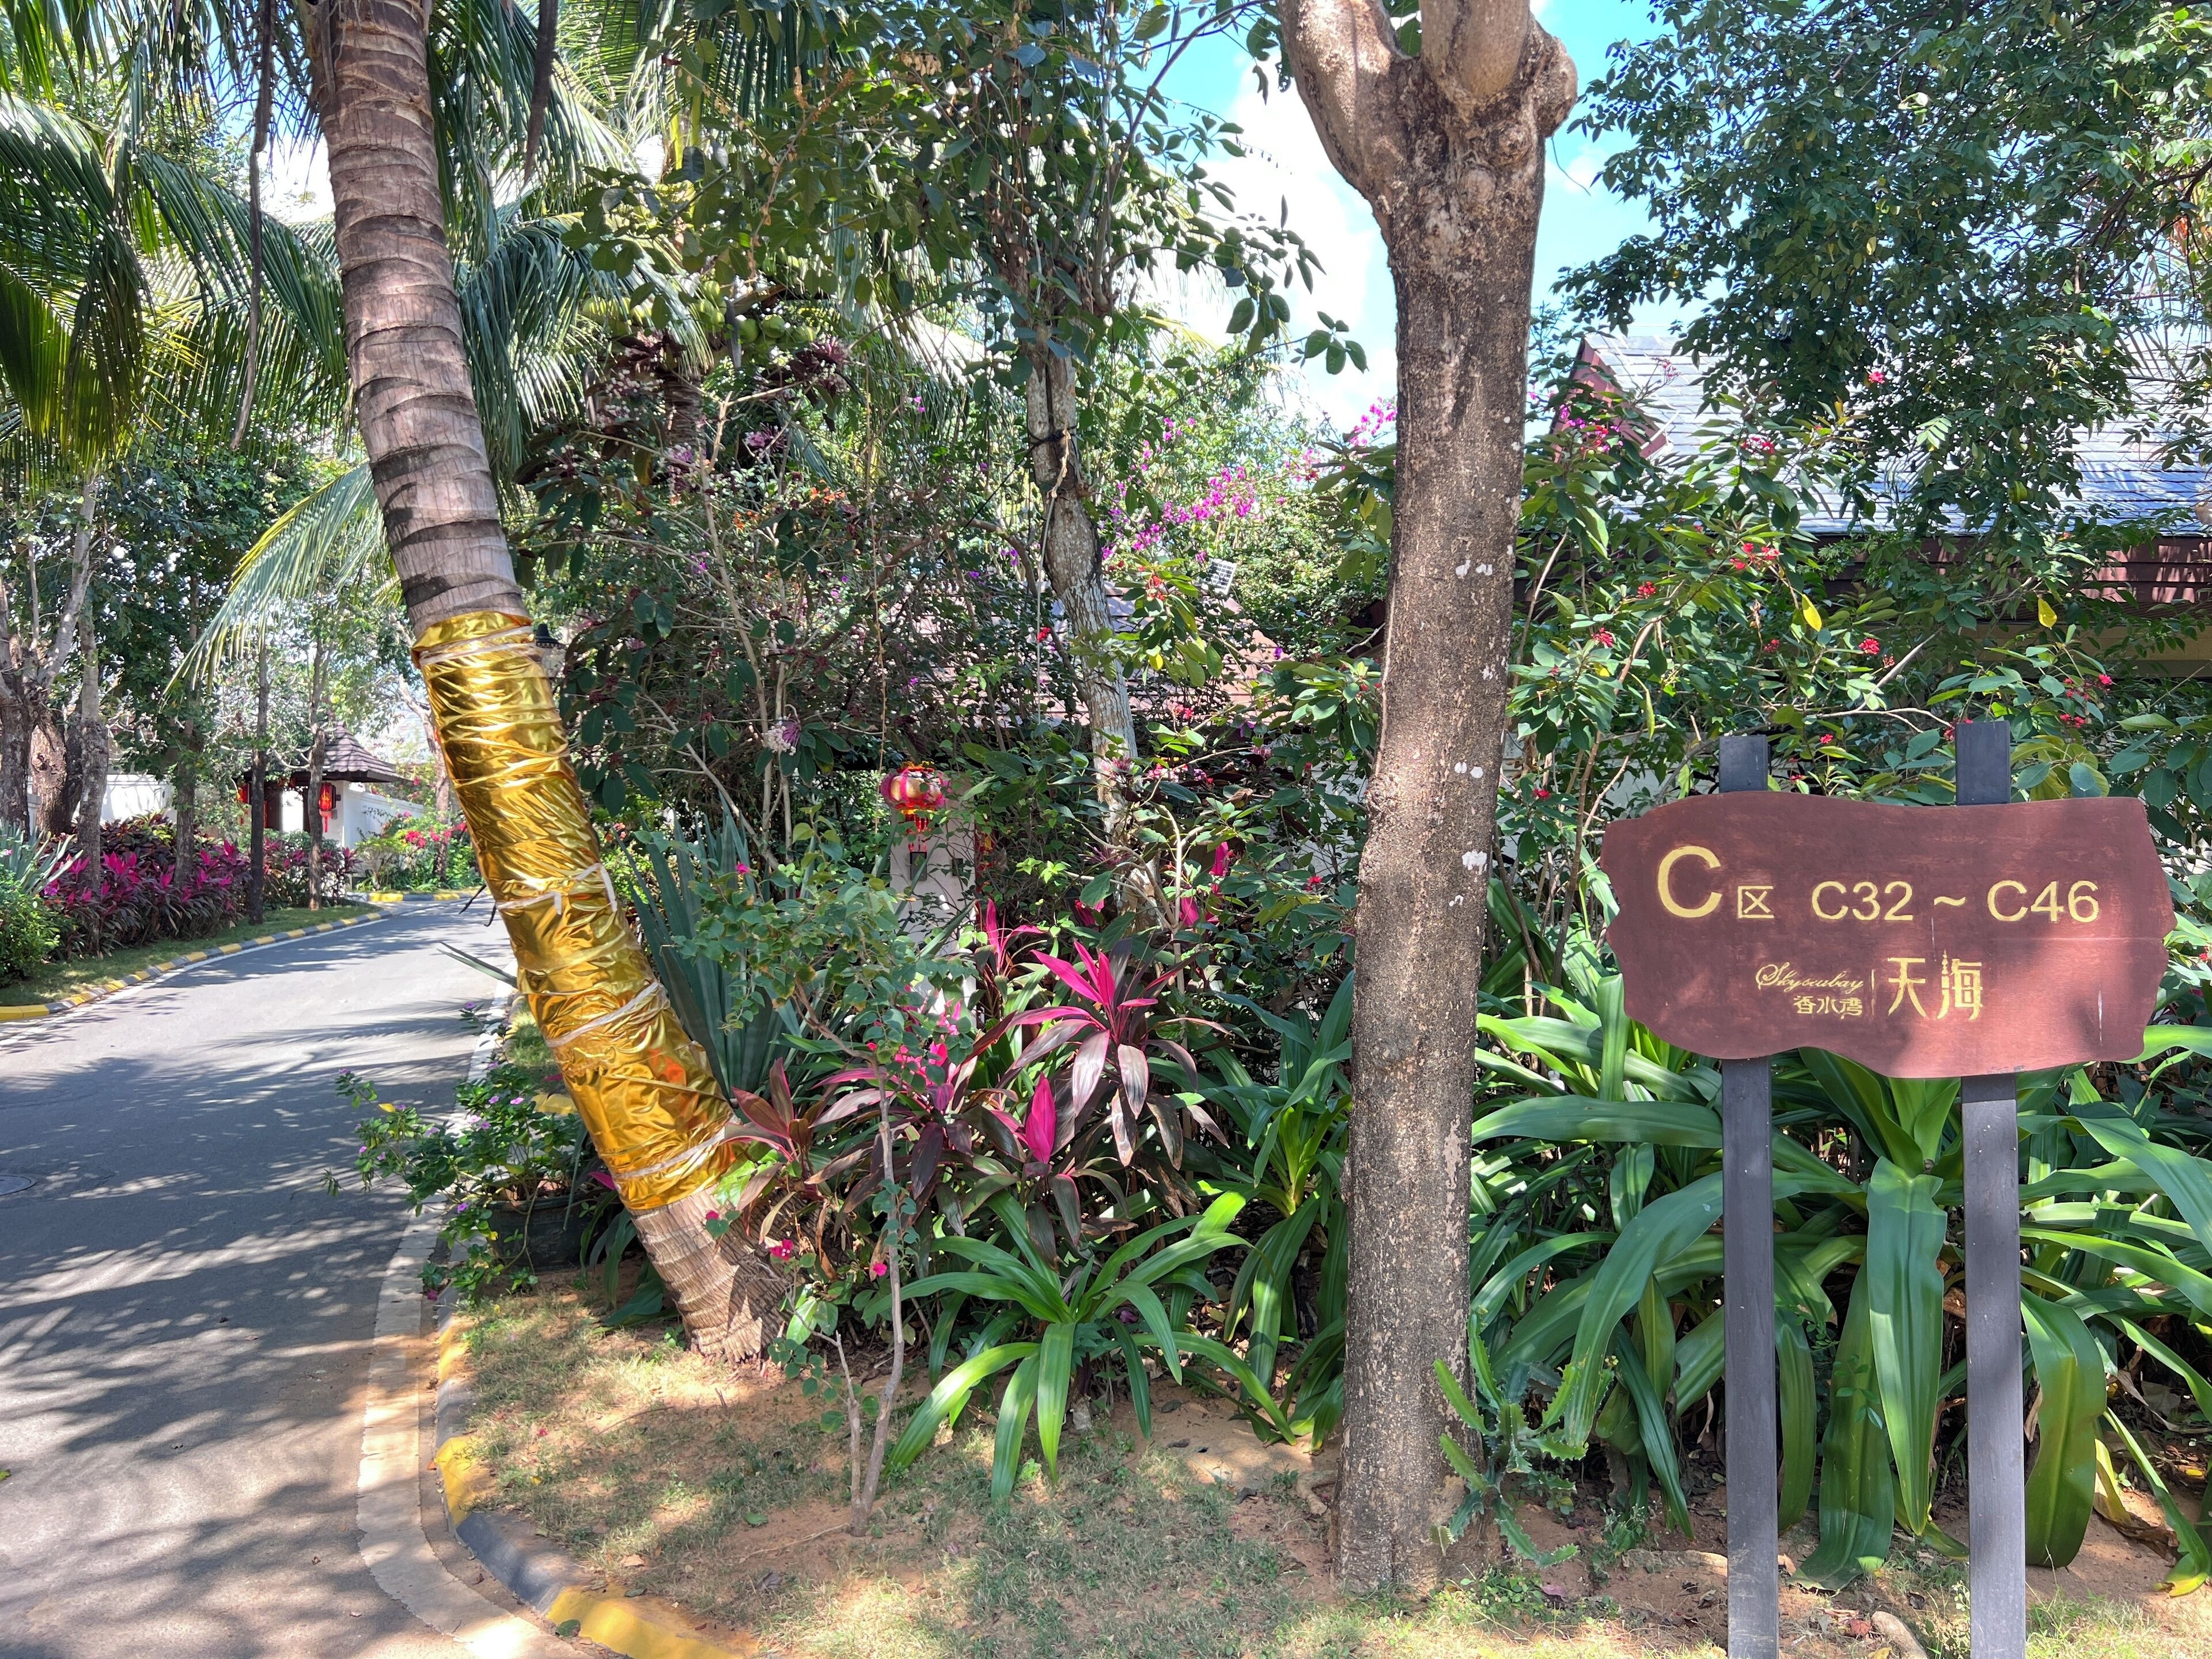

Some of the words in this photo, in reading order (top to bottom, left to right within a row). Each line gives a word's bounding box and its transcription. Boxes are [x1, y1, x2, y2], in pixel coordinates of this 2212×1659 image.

[1812, 881, 1914, 921] C32
[1987, 880, 2099, 922] C46
[1887, 949, 1983, 1020] 天海
[1793, 995, 1863, 1020] 香水湾
